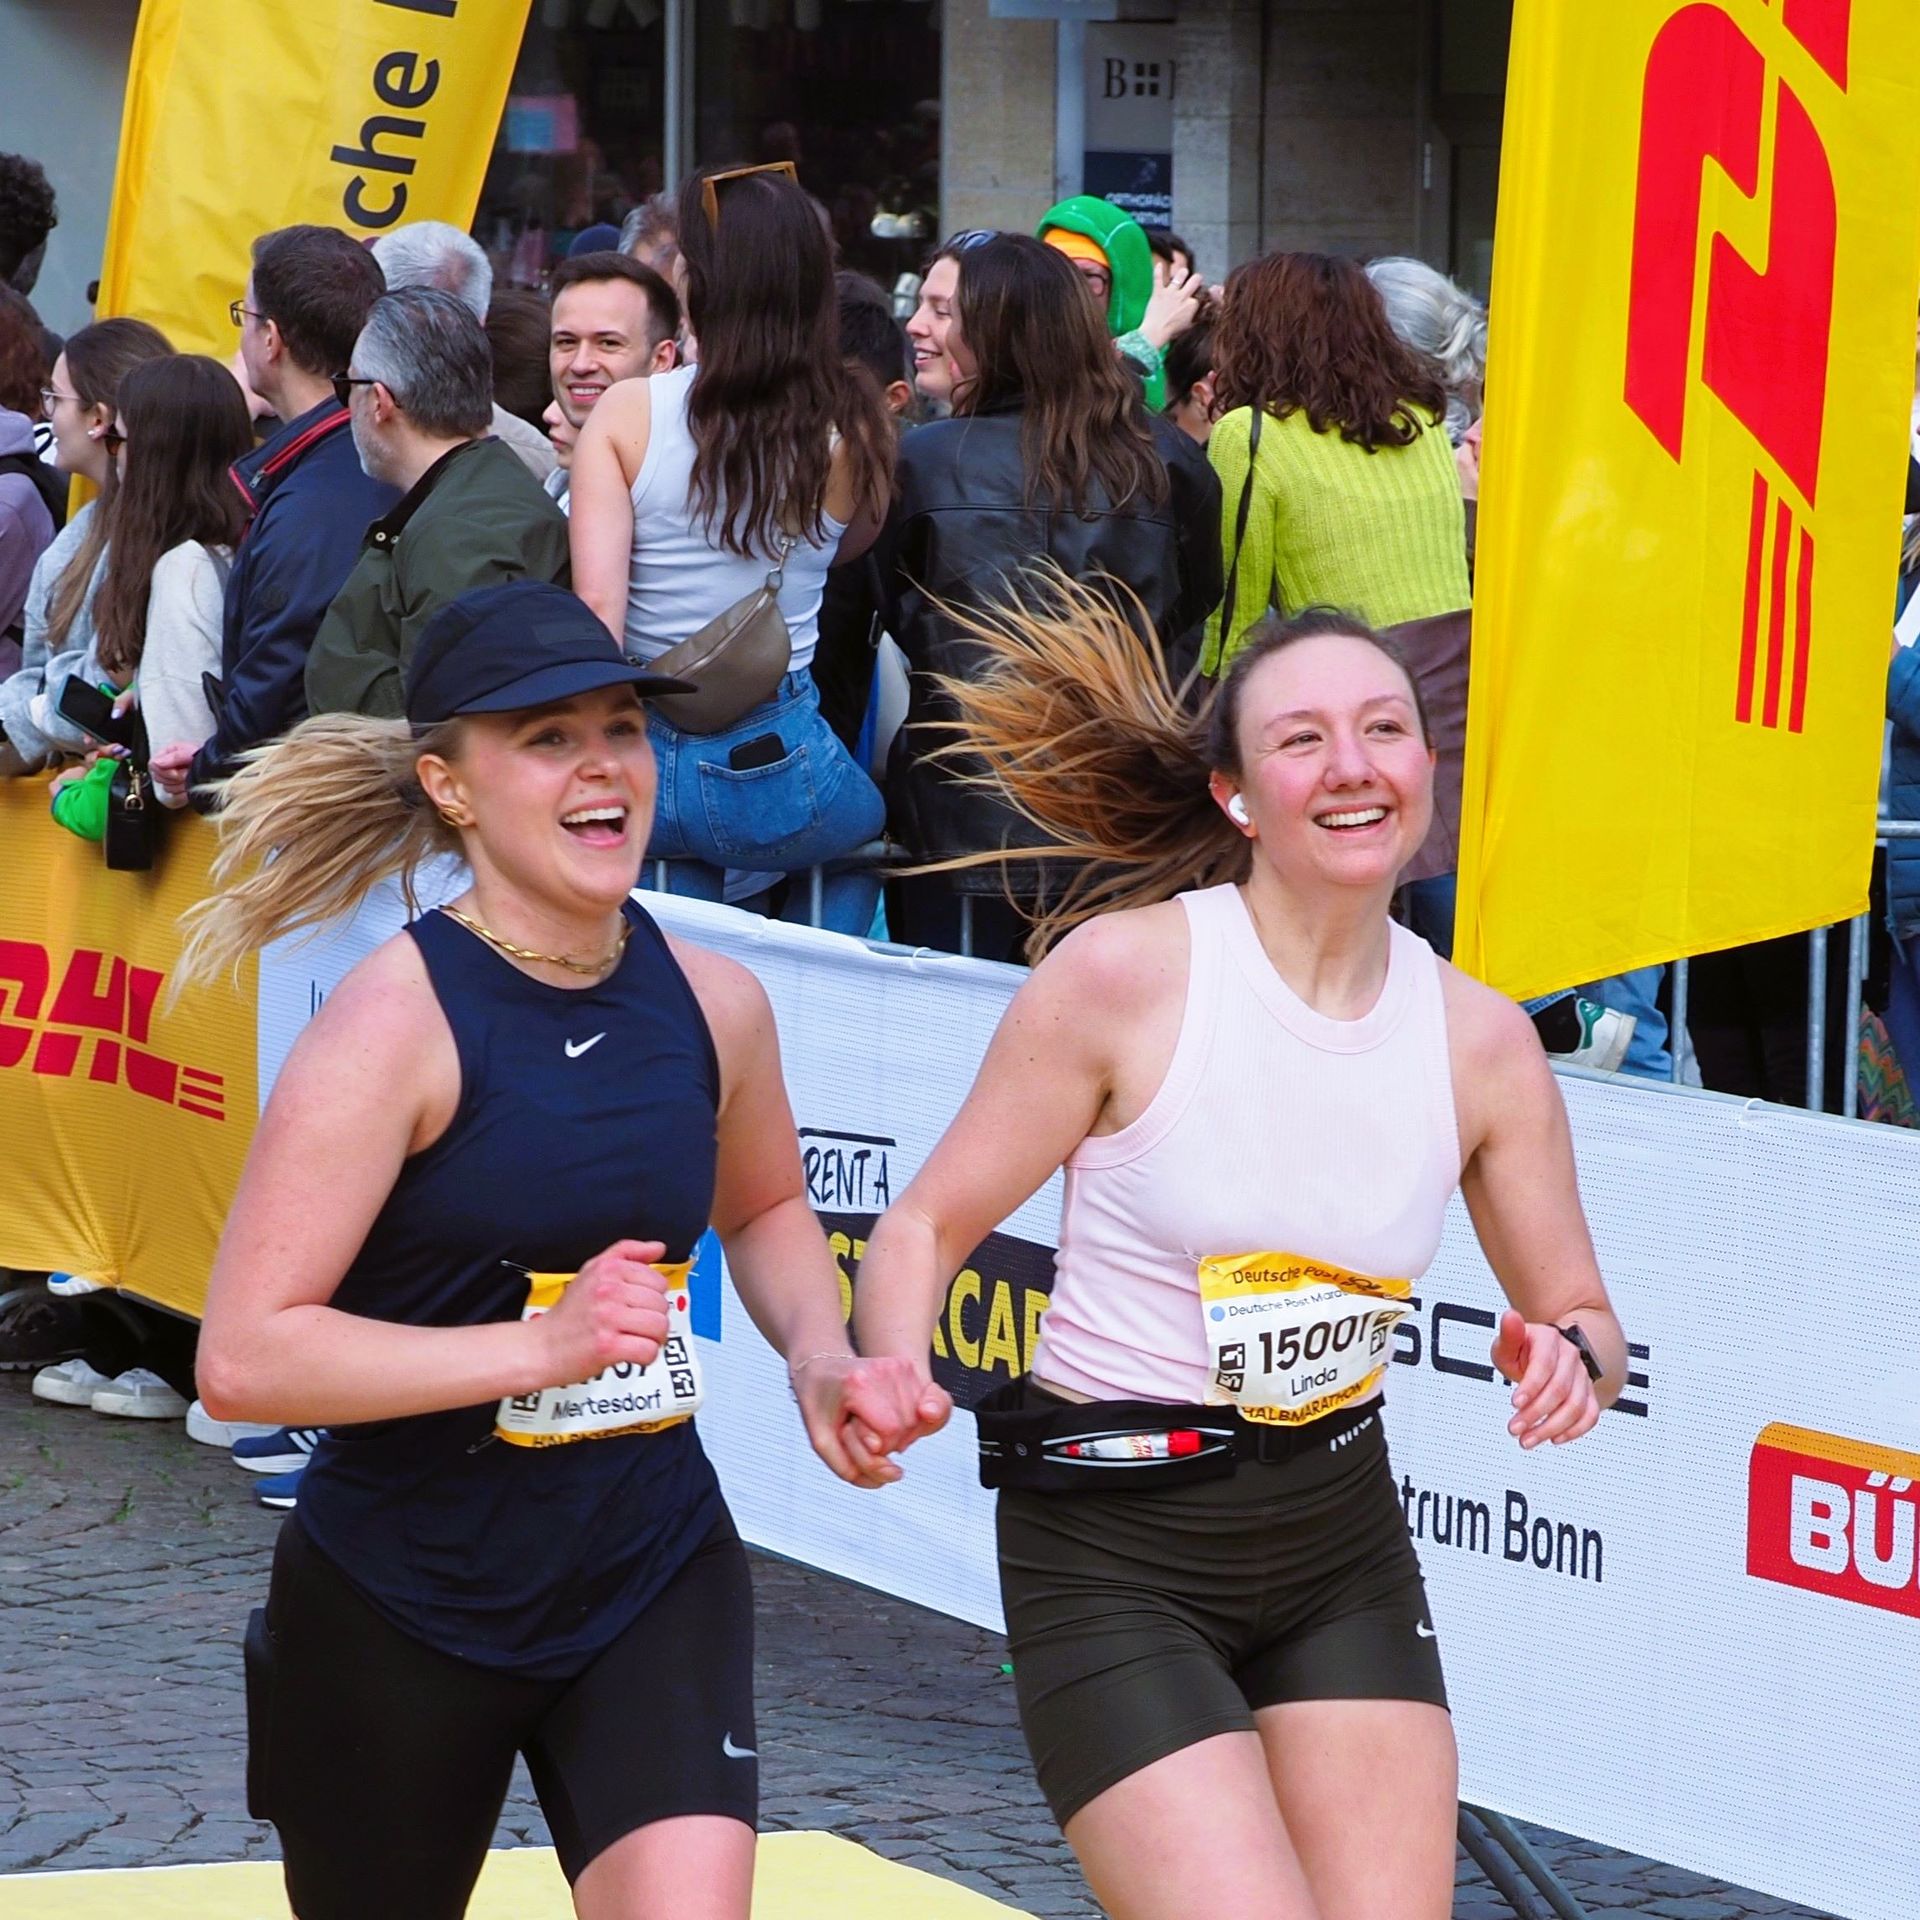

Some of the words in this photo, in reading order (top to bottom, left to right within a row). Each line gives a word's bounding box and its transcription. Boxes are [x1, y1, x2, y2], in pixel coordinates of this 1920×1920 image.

[803, 1146, 871, 1206] RENT
[873, 1151, 890, 1206] A
[1233, 1267, 1300, 1284] Deutsche
[1228, 1300, 1284, 1317] Deutsche
[1286, 1298, 1309, 1309] Post
[1291, 1367, 1338, 1396] Linda
[551, 1389, 662, 1420] Mertesdorf
[1402, 1475, 1490, 1554] trum
[1503, 1489, 1603, 1582] Bonn
[1790, 1471, 1920, 1590] BÜ
